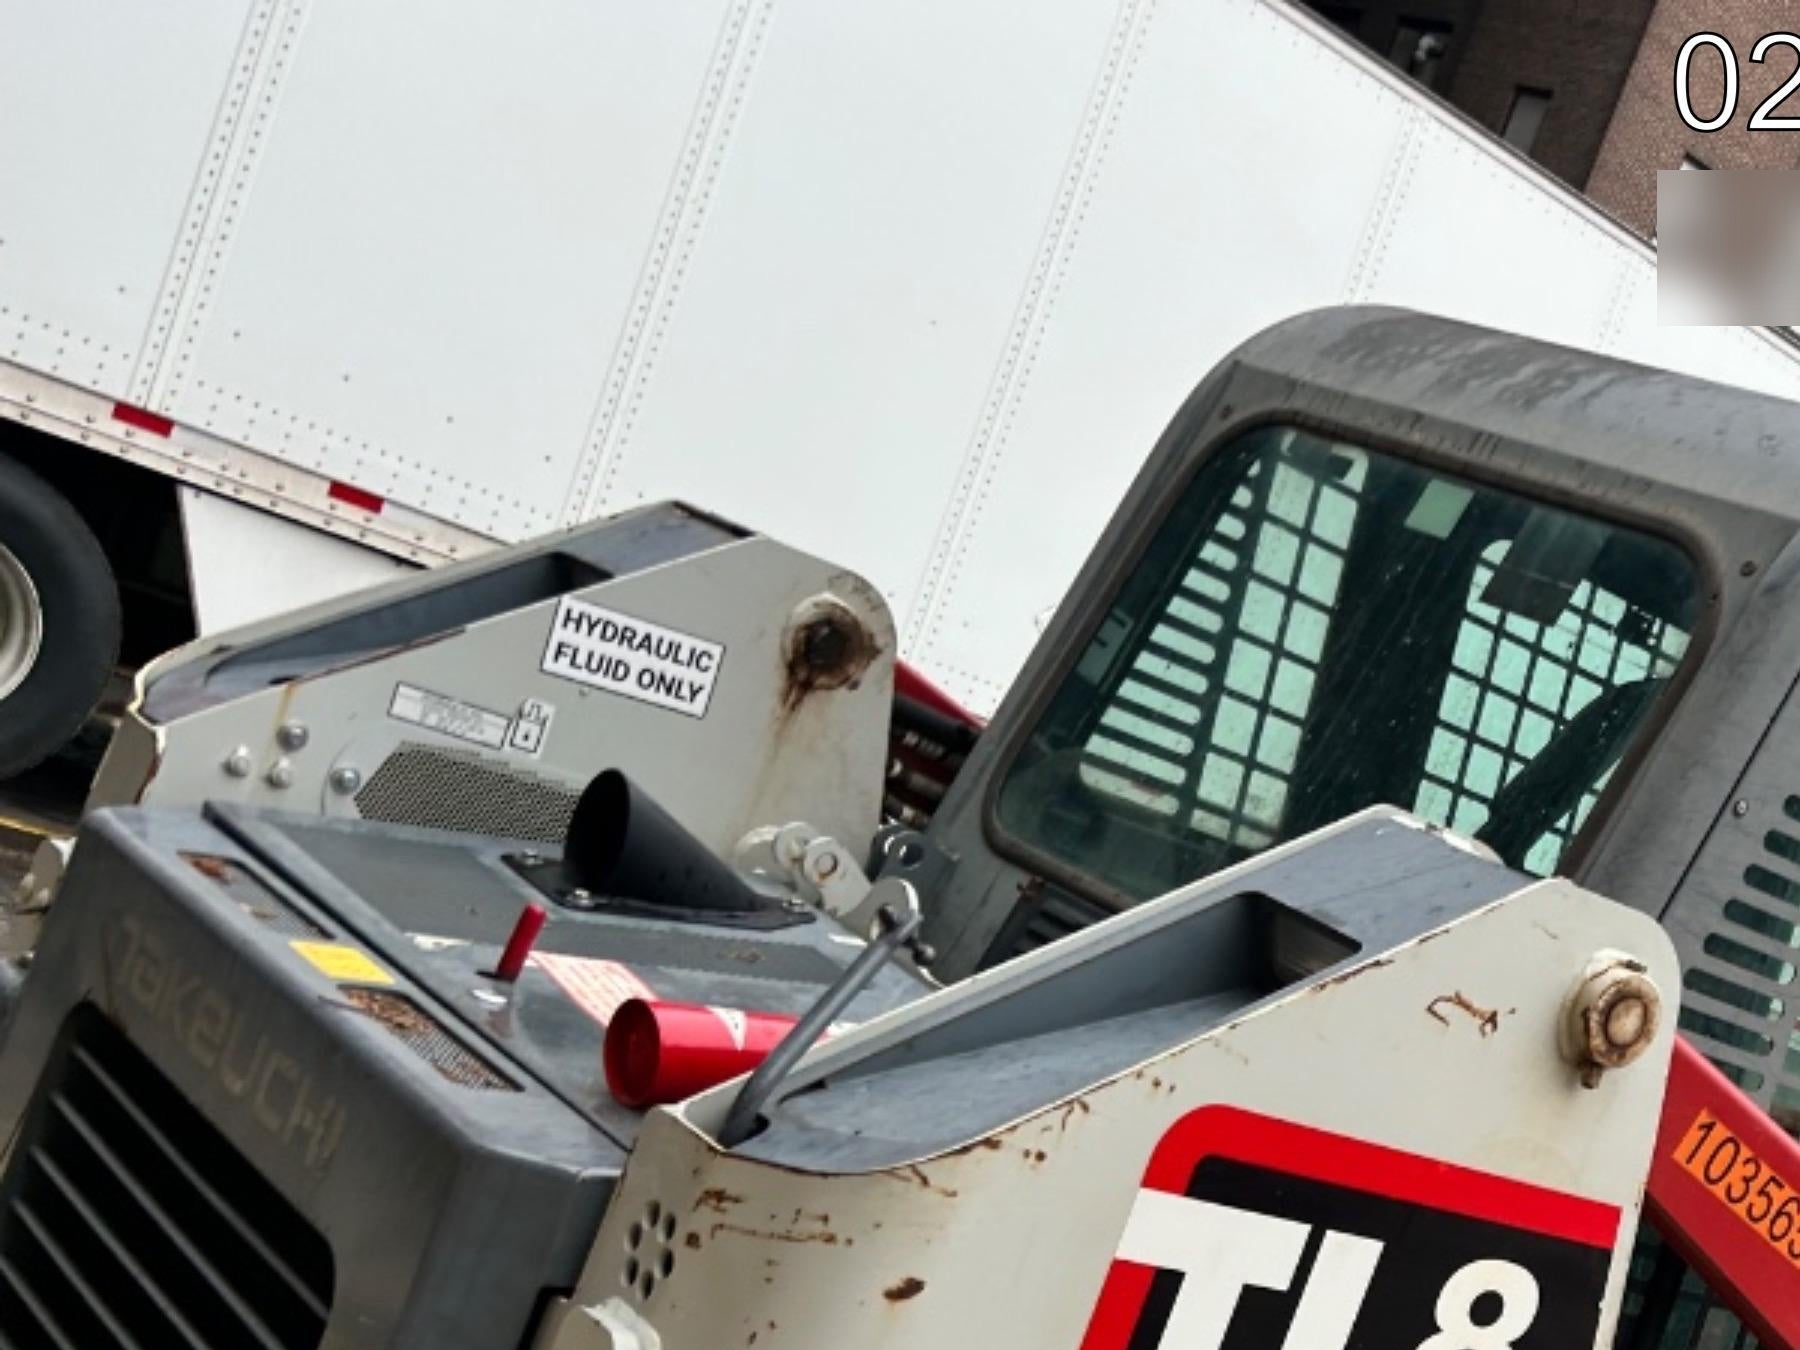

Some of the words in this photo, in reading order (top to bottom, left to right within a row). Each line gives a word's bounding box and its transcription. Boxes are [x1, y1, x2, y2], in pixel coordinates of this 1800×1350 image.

[561, 607, 714, 673] HYDRAULIC
[553, 641, 631, 682] FLUID
[636, 668, 705, 704] ONLY
